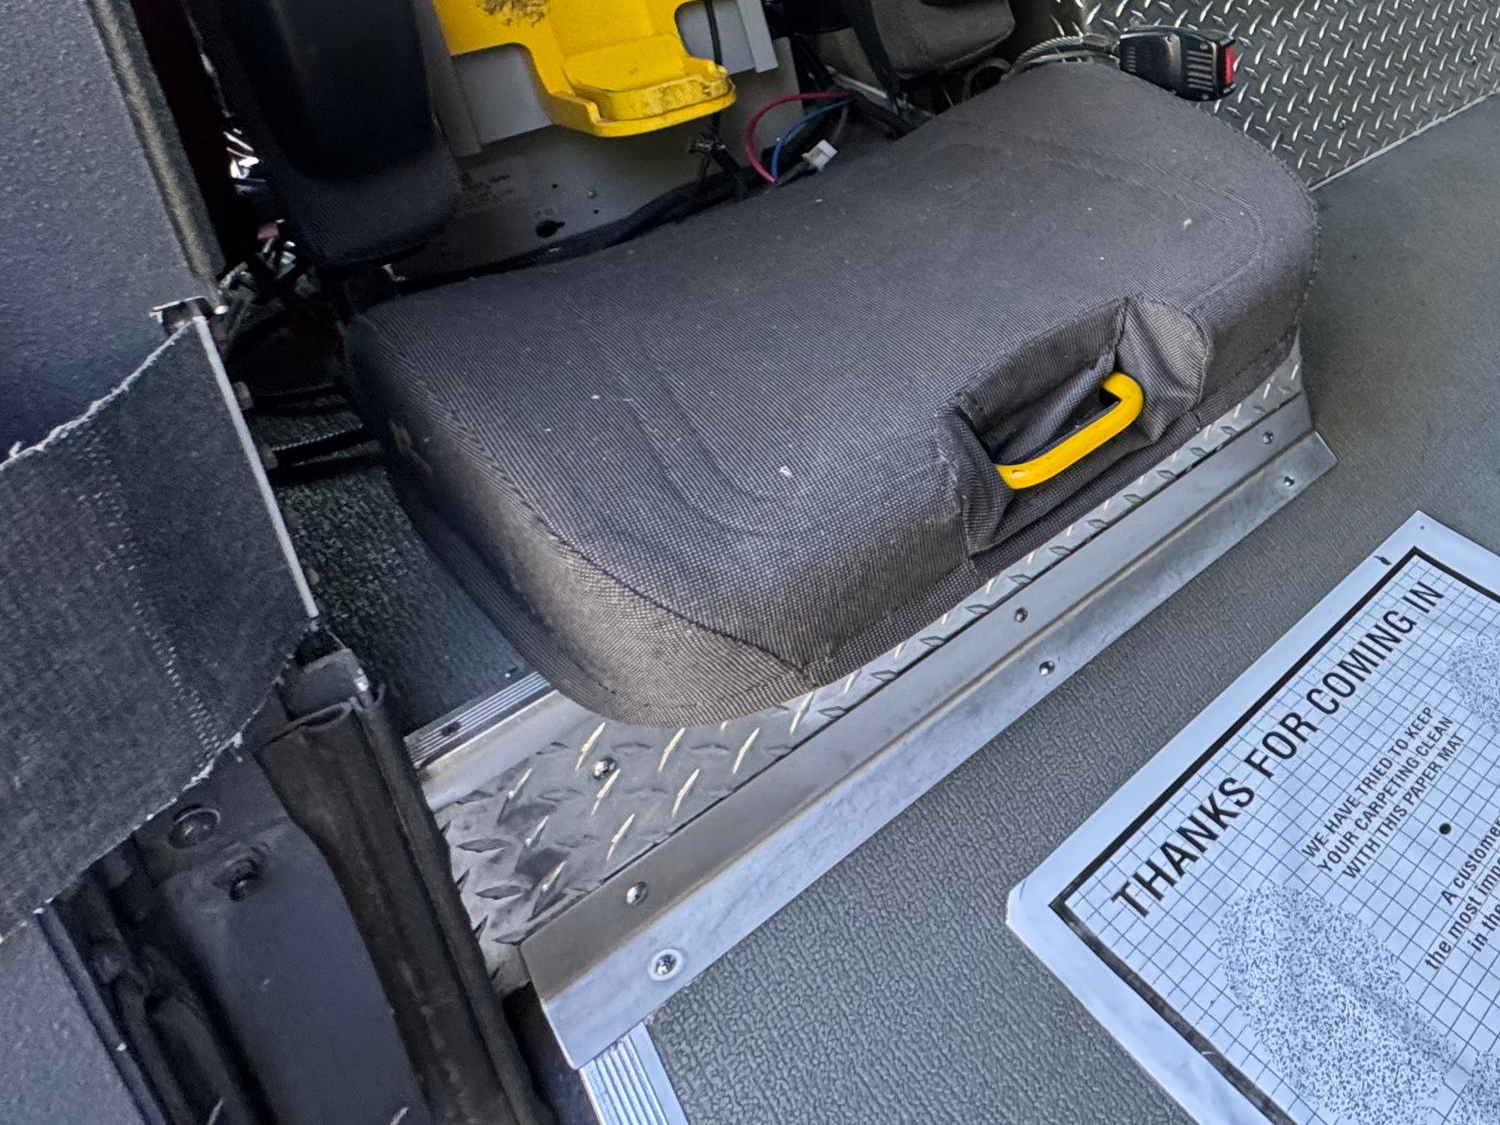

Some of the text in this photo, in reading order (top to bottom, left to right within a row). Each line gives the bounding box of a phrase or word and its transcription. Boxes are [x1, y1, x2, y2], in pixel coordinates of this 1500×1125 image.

[1110, 580, 1445, 918] THANKS FOR COMING IN
[1301, 707, 1435, 859] WE HAVE TRIED TO KEEP
[1318, 716, 1454, 874] YOUR CARPETING CLEAN
[1342, 731, 1465, 880] WITH THIS PAPER MAT
[1425, 941, 1451, 971] the
[1448, 895, 1482, 940] most
[1440, 889, 1458, 906] A
[1467, 932, 1489, 953] in
